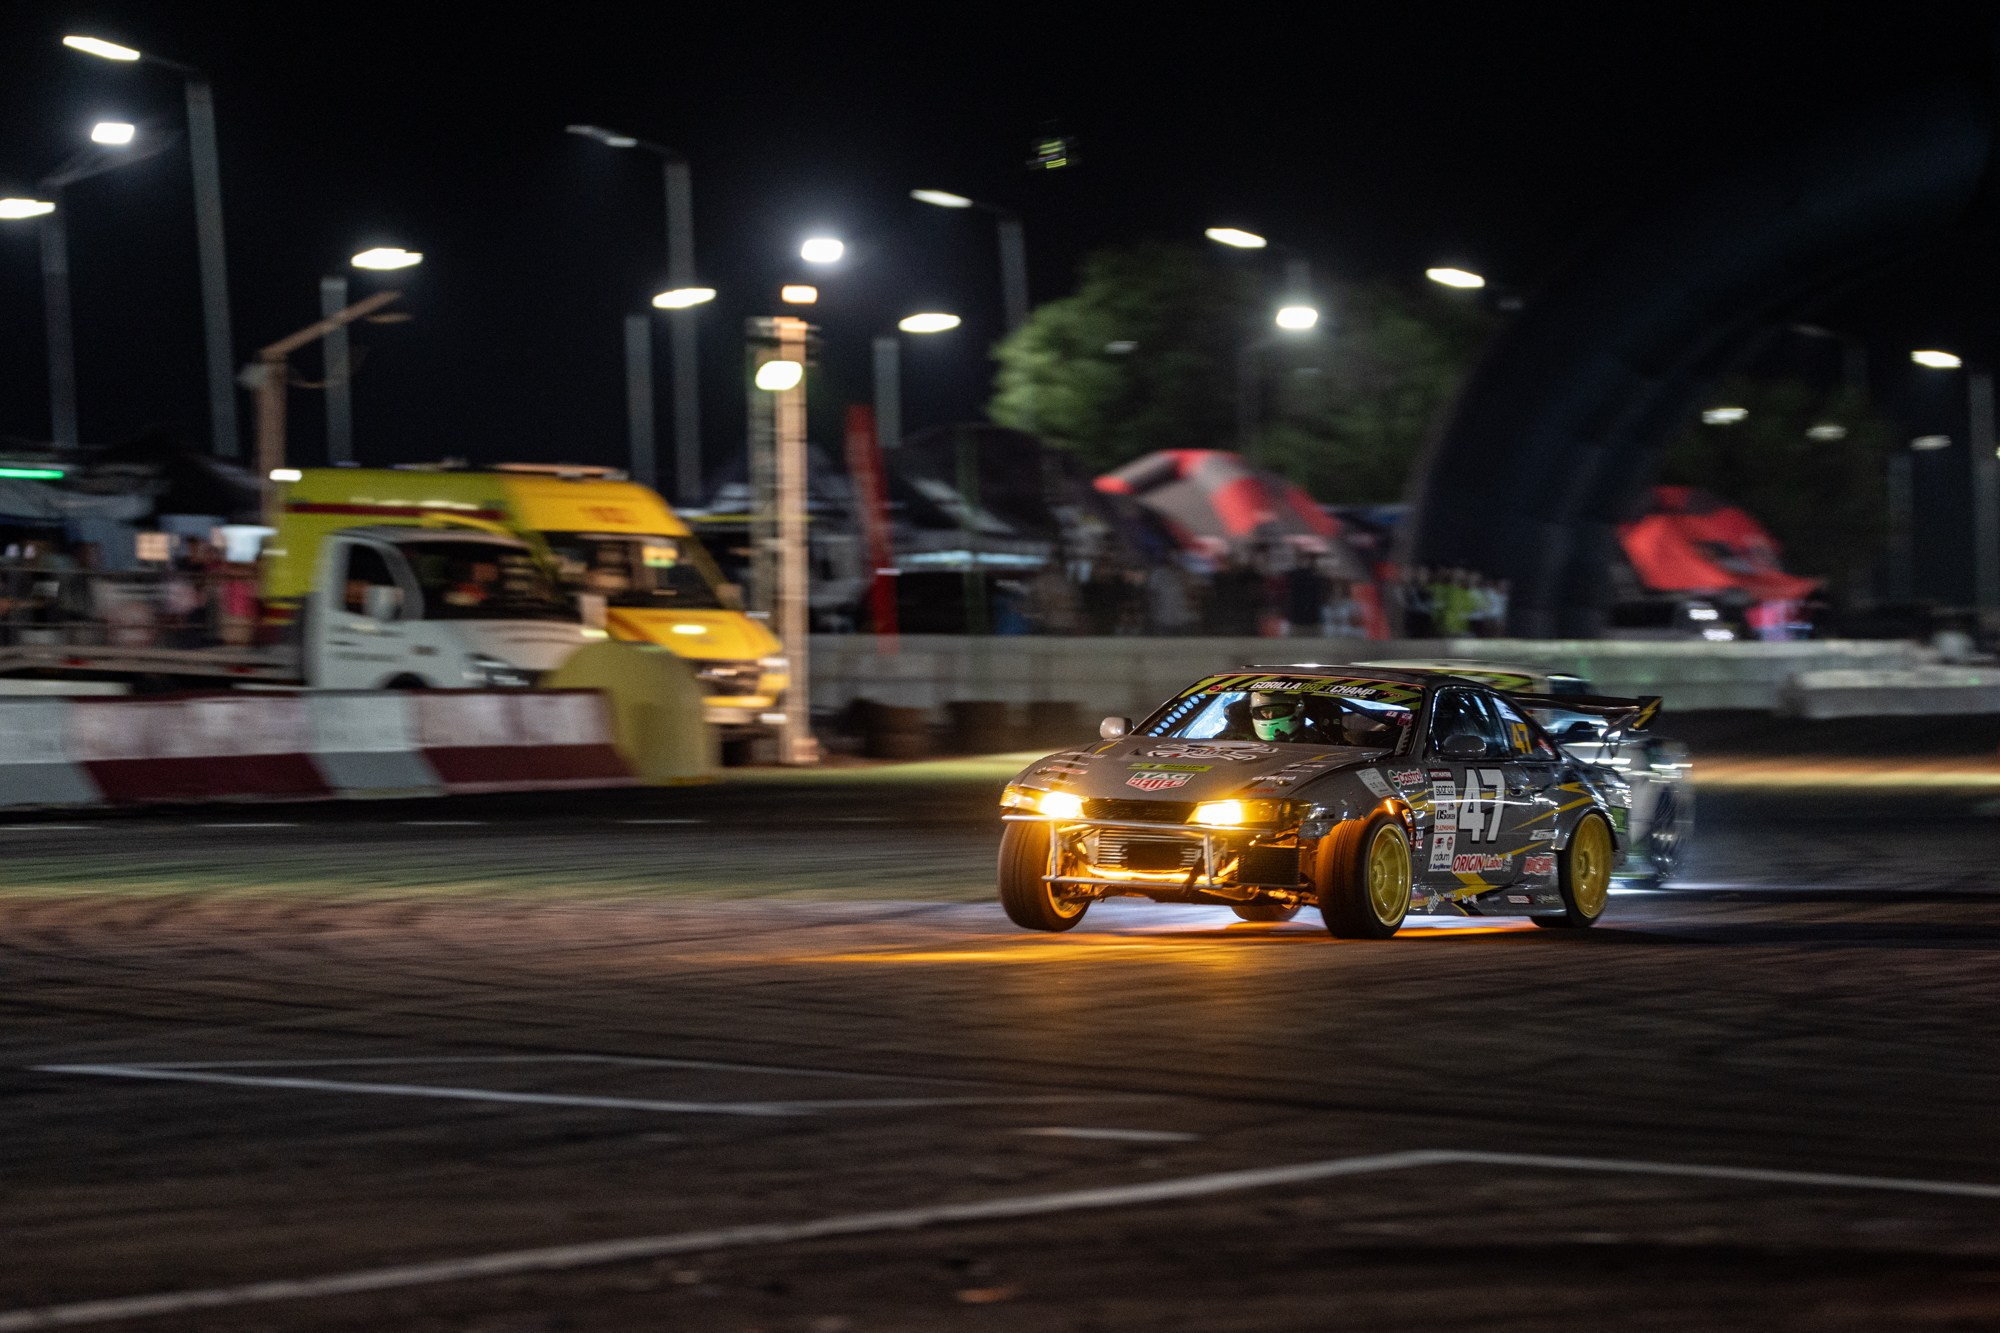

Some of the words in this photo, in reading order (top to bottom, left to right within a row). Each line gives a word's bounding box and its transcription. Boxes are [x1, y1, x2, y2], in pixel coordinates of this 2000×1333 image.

[1511, 723, 1534, 755] 47
[1142, 772, 1188, 780] TAG
[1399, 770, 1423, 785] Castrol
[1130, 779, 1184, 790] HEUER
[1459, 768, 1506, 842] 47
[1453, 855, 1484, 873] ORIGIN
